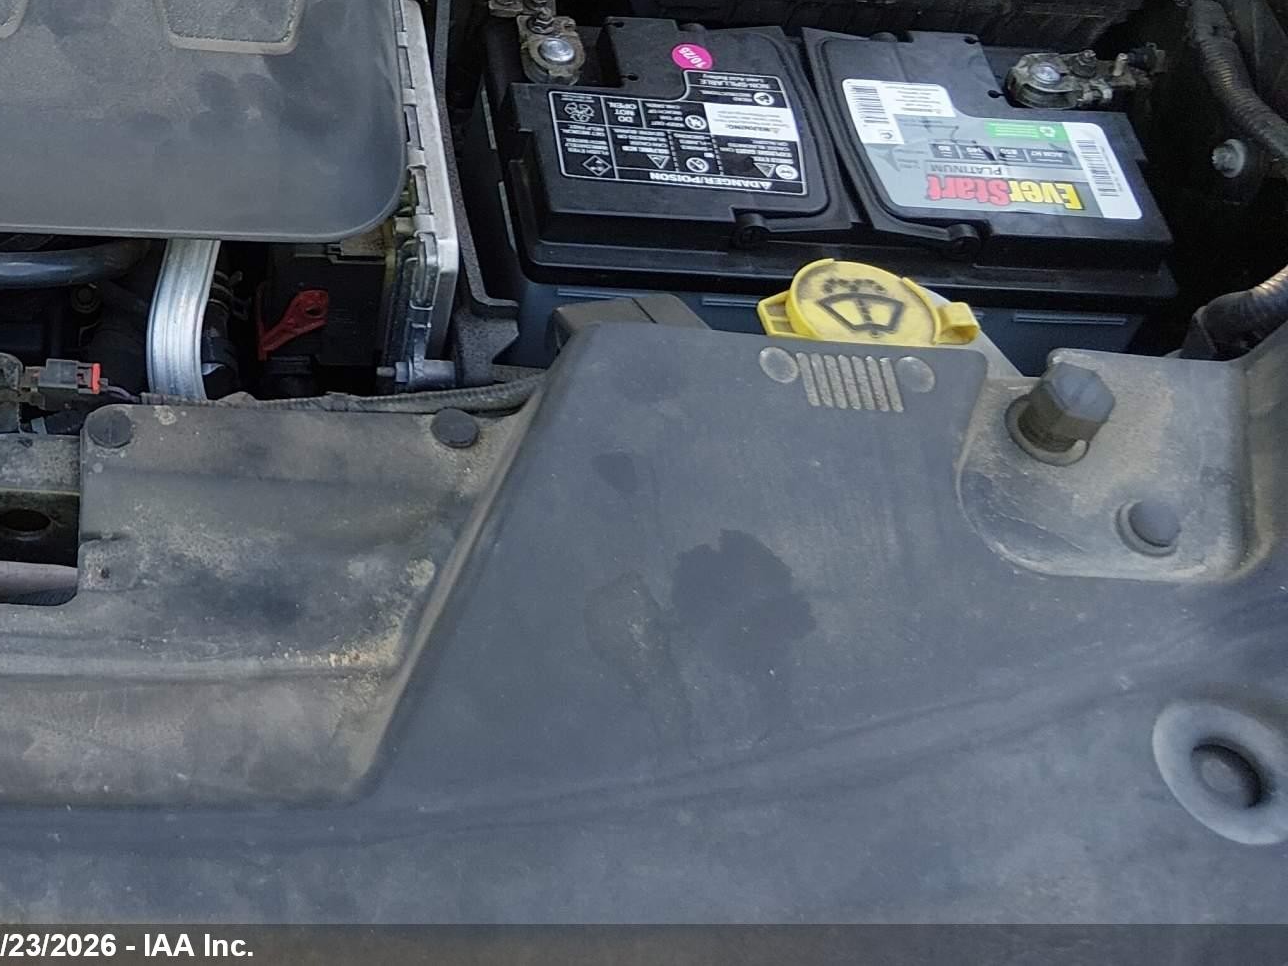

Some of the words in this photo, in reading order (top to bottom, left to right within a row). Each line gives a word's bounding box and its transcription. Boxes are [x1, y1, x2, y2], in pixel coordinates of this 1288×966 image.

[930, 164, 1002, 175] PLATINUM
[649, 172, 762, 189] DANGER/POISON
[926, 174, 1085, 210] EverStart
